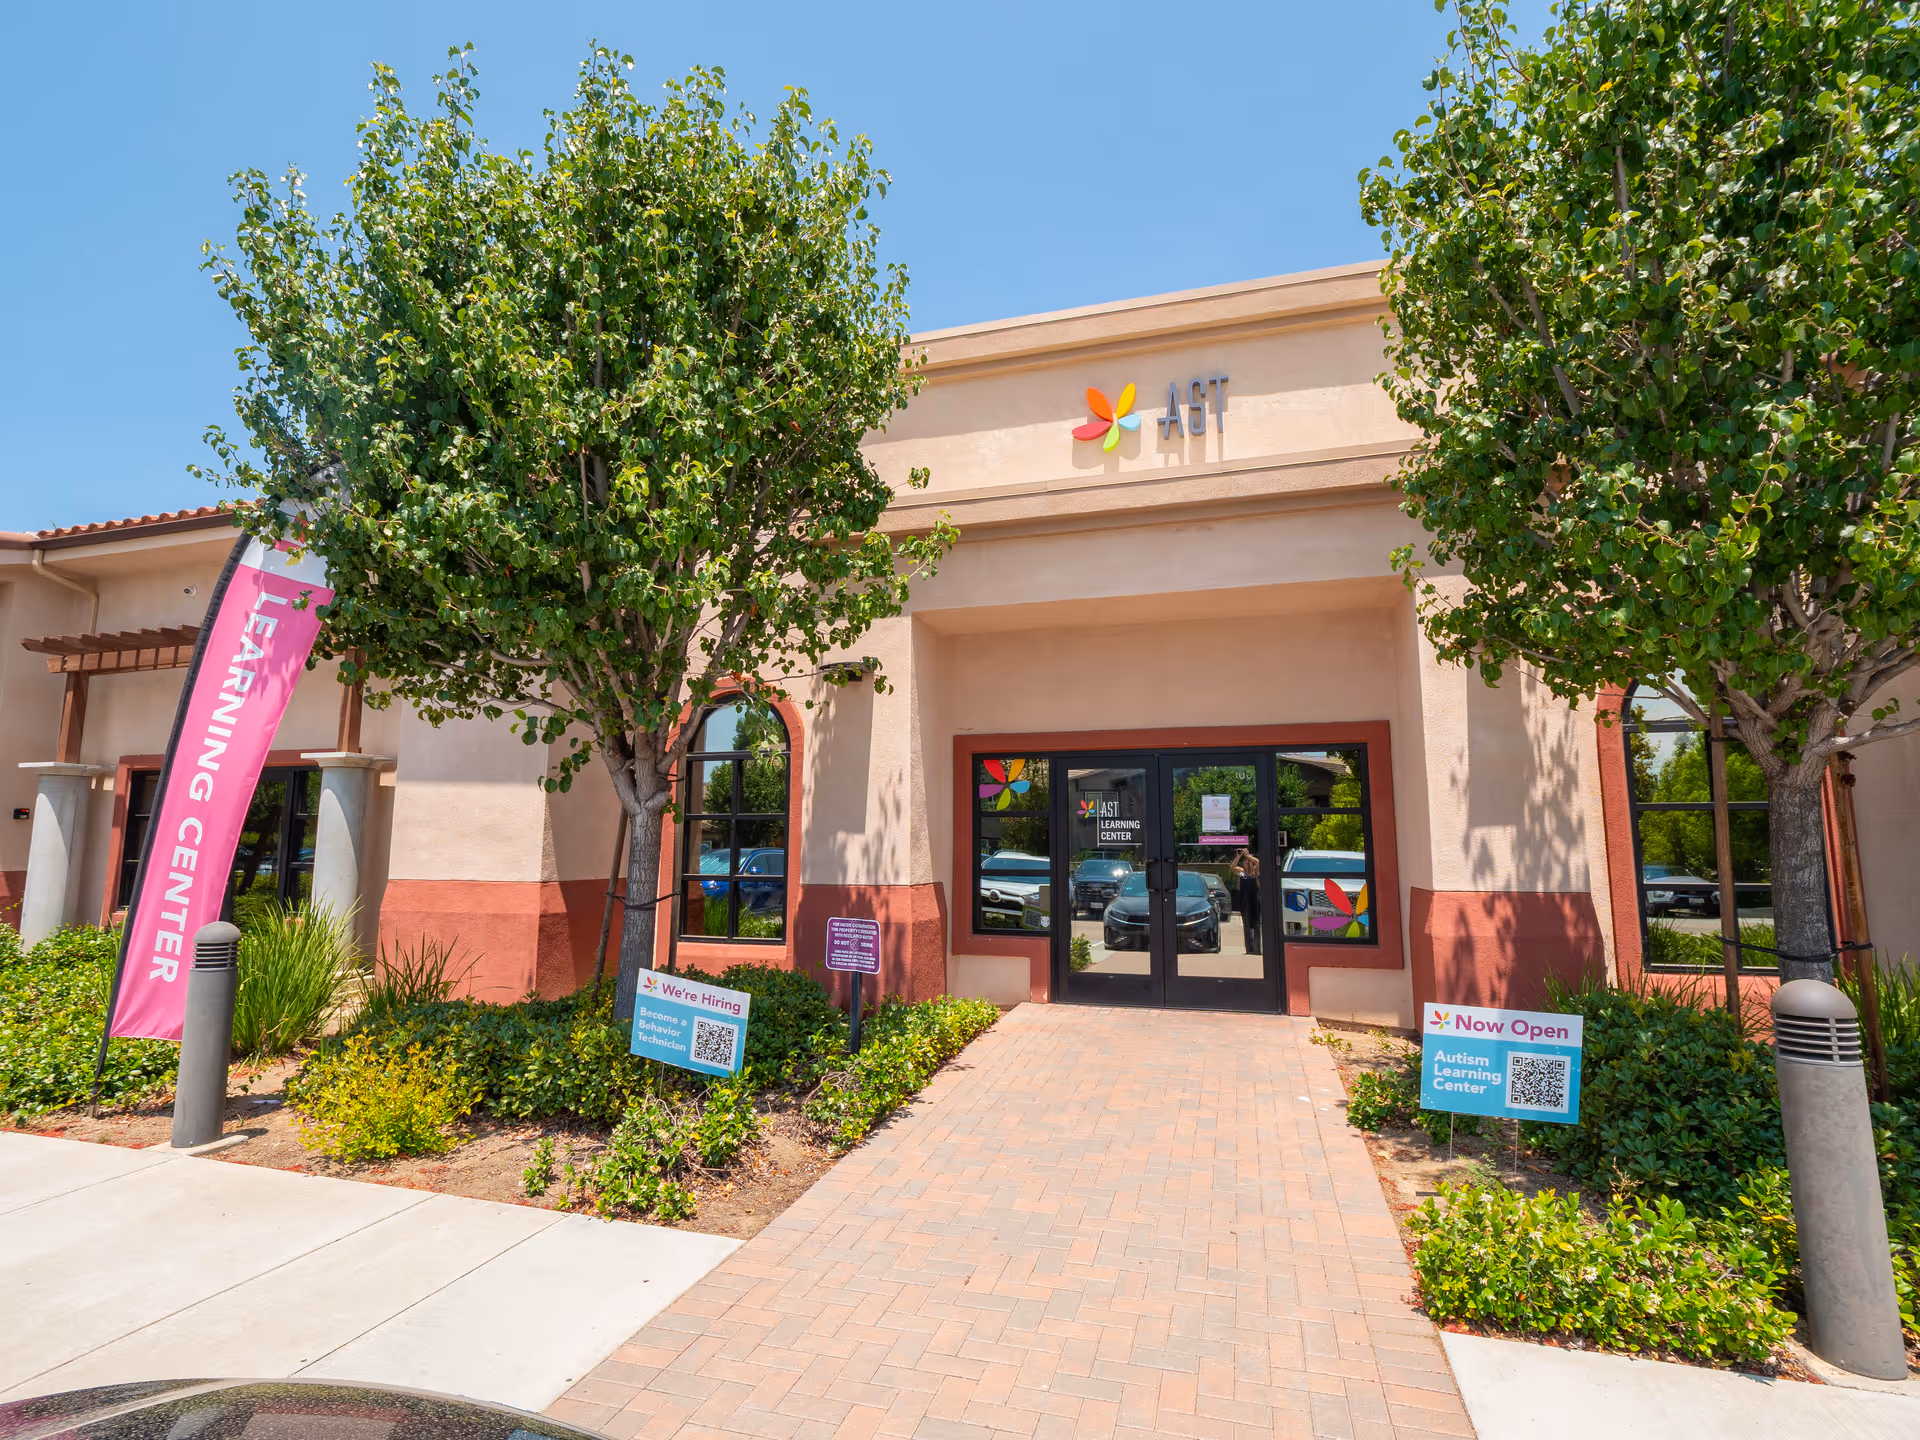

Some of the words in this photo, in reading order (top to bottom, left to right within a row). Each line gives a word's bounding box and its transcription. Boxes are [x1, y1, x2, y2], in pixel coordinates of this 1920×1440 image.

[1157, 375, 1228, 440] AST
[189, 590, 289, 802] LEARNING
[1100, 801, 1119, 817] AST
[1101, 820, 1140, 829] LEARNING
[1101, 832, 1131, 840] CENTER
[149, 817, 203, 984] CENTER
[662, 983, 697, 1002] We're
[702, 993, 741, 1015] Hiring
[640, 1007, 678, 1024] Become
[639, 1020, 681, 1037] Behavior
[1456, 1014, 1504, 1033] Now
[1511, 1019, 1568, 1041] Open
[638, 1032, 686, 1052] Technician
[1434, 1050, 1489, 1066] Autism
[1434, 1064, 1501, 1085] Learning
[1433, 1078, 1487, 1094] Center
